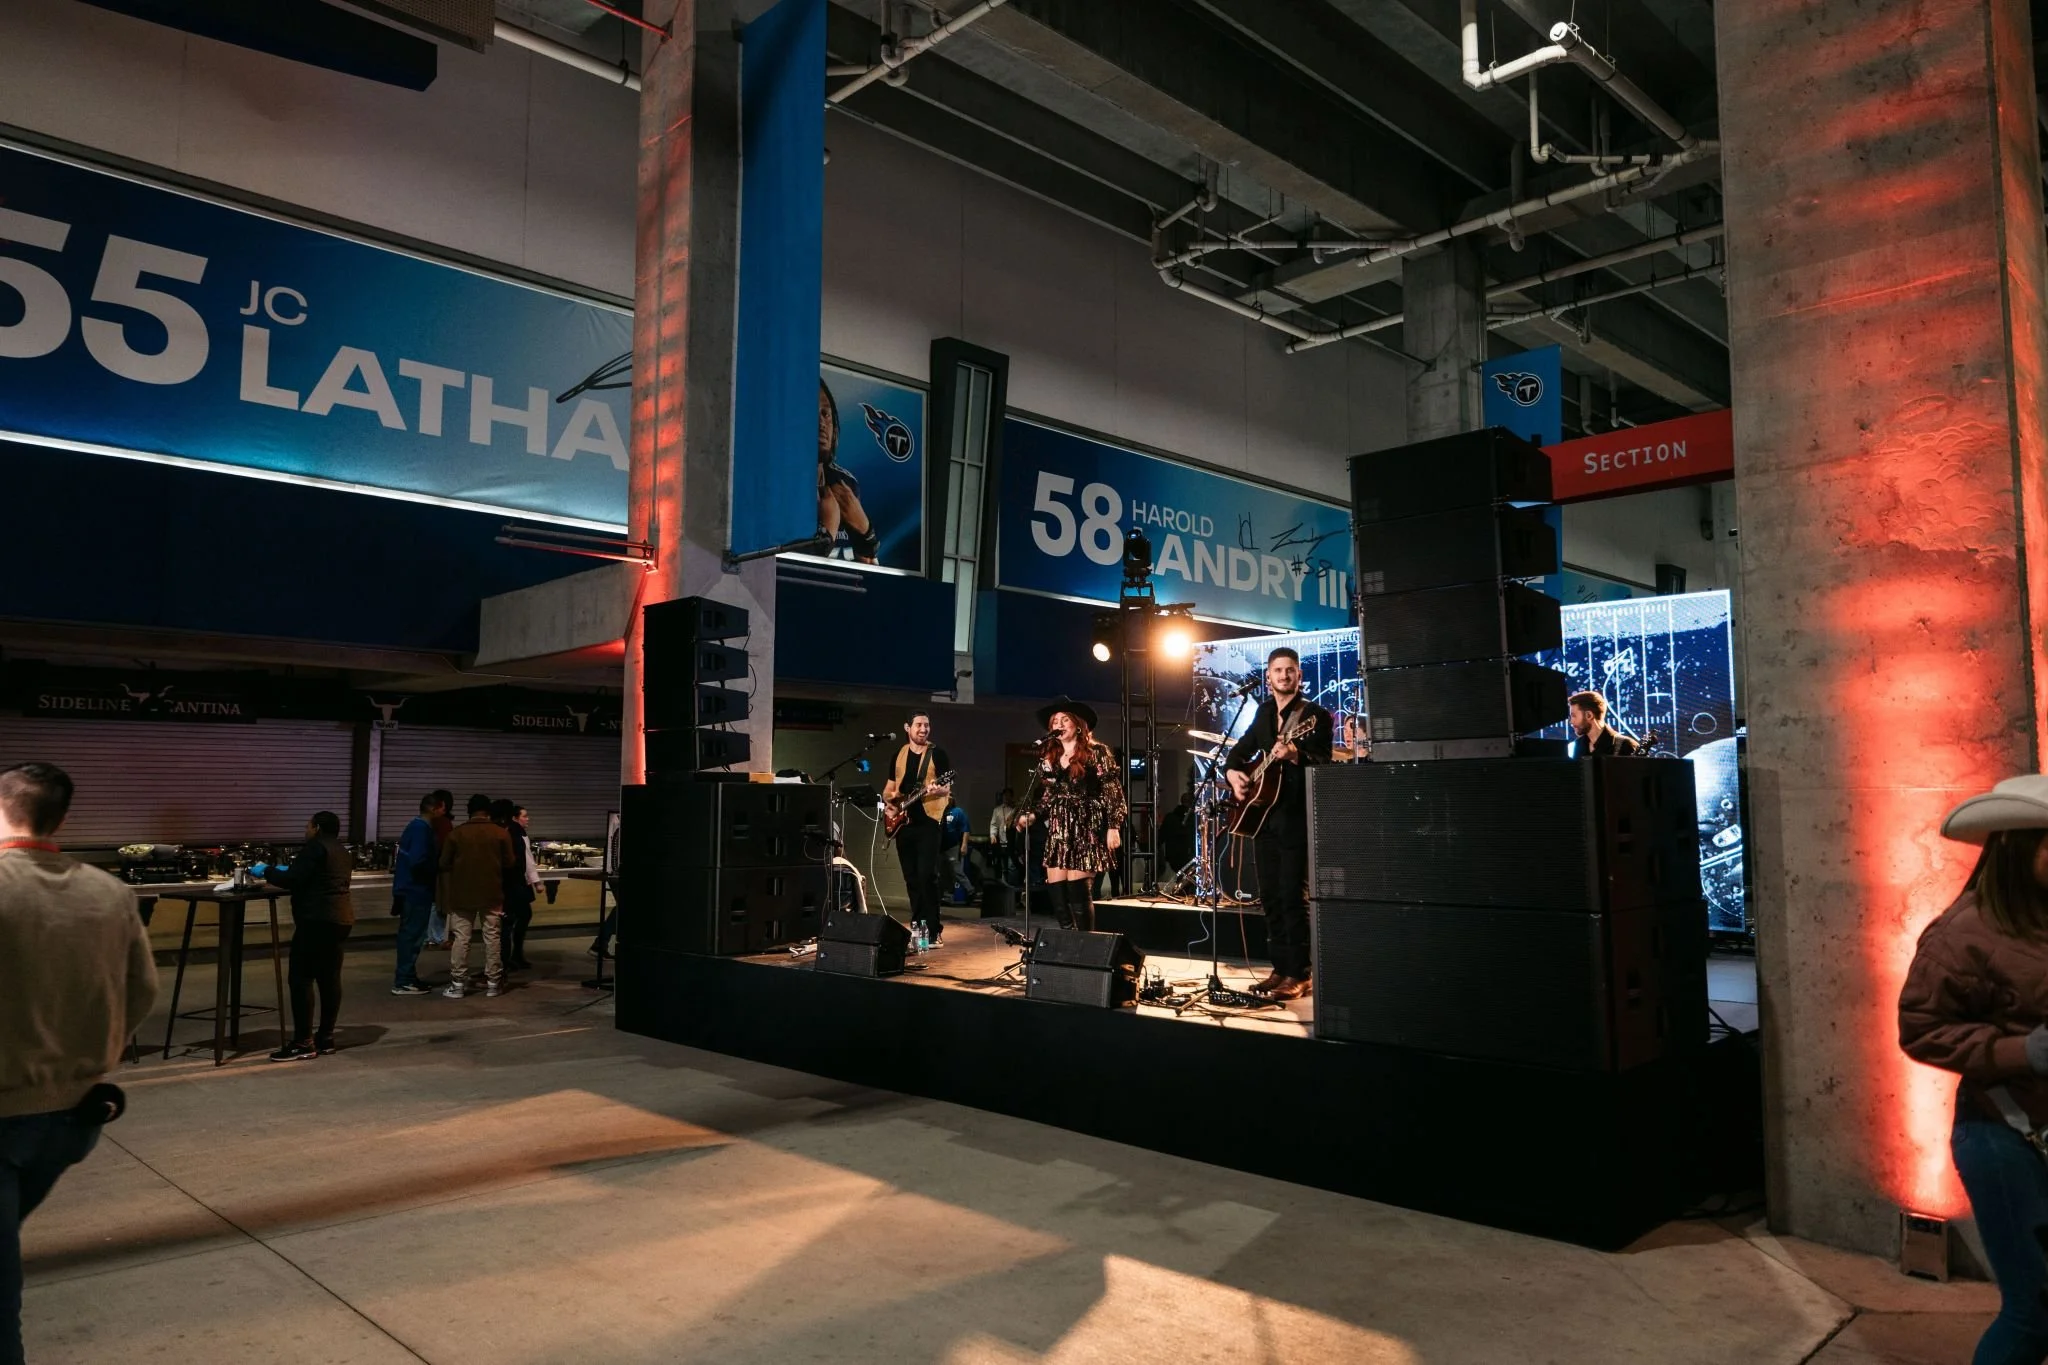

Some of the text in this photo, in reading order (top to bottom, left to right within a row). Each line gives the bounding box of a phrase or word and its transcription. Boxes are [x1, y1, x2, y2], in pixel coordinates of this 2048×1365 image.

[0, 206, 209, 385] 55
[239, 280, 308, 326] JC
[1583, 440, 1687, 475] SECTION
[1031, 470, 1123, 566] 58
[1132, 499, 1214, 537] HAROLD
[1132, 526, 1305, 602] ANDRY
[38, 693, 132, 712] SIDELINE
[512, 714, 574, 729] SIDELINE
